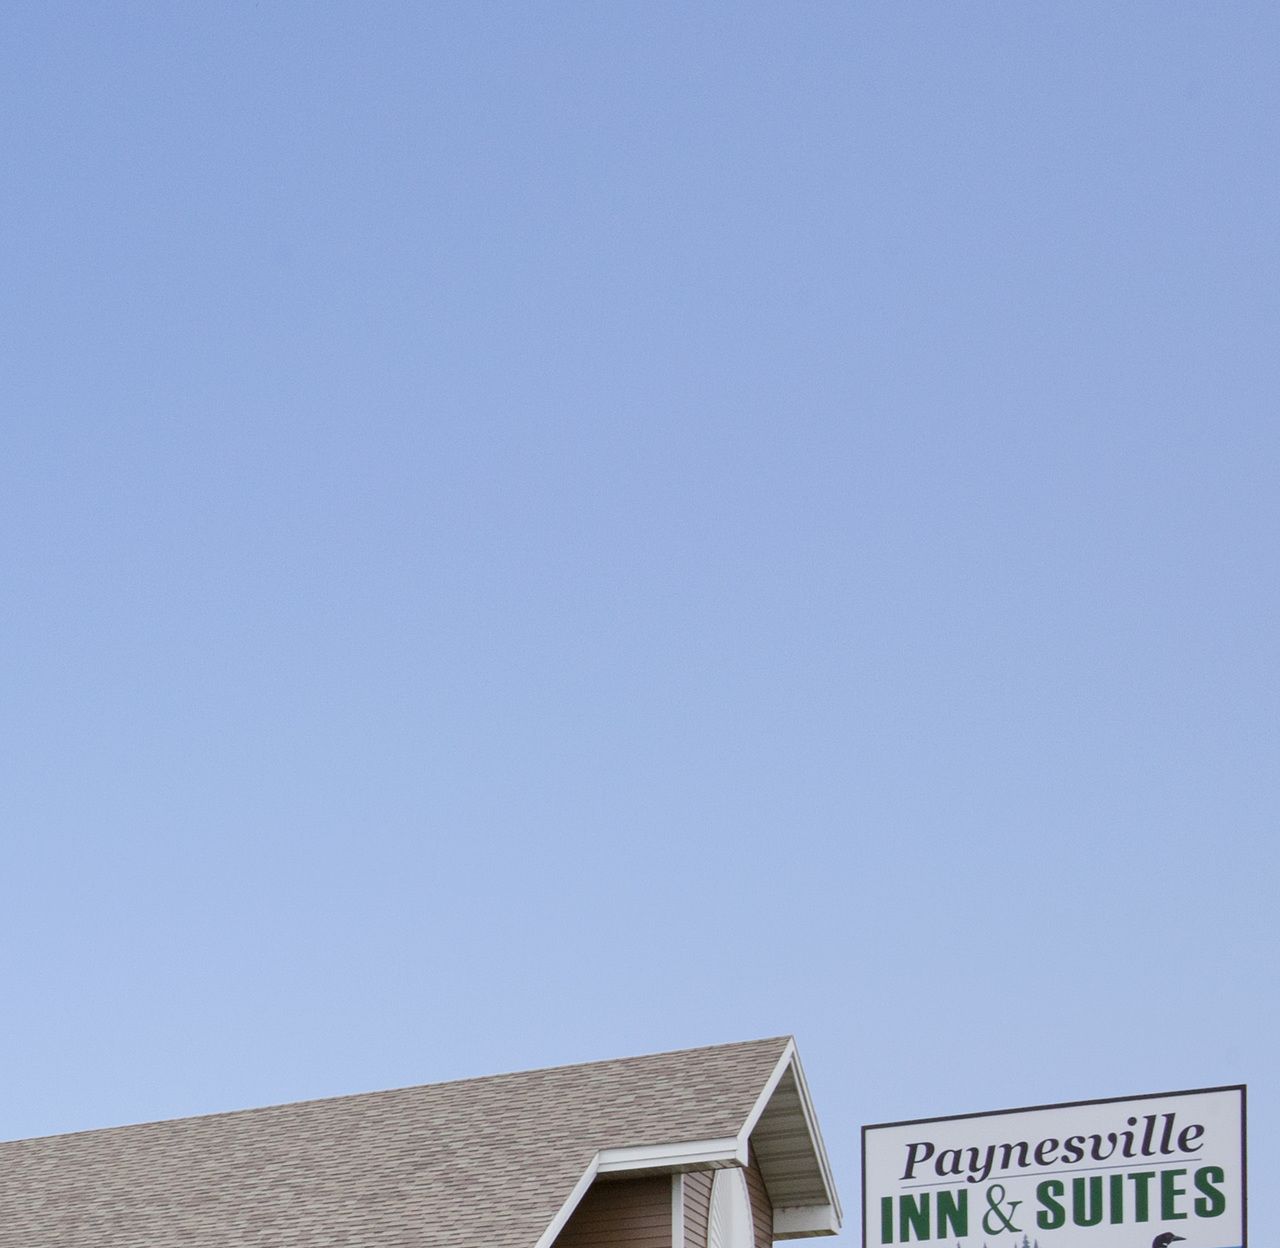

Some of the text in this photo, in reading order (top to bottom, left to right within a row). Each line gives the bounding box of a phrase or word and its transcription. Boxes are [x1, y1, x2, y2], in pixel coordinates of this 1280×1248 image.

[899, 1112, 1205, 1183] Paynesville
[881, 1166, 1226, 1244] INN & SUITES
